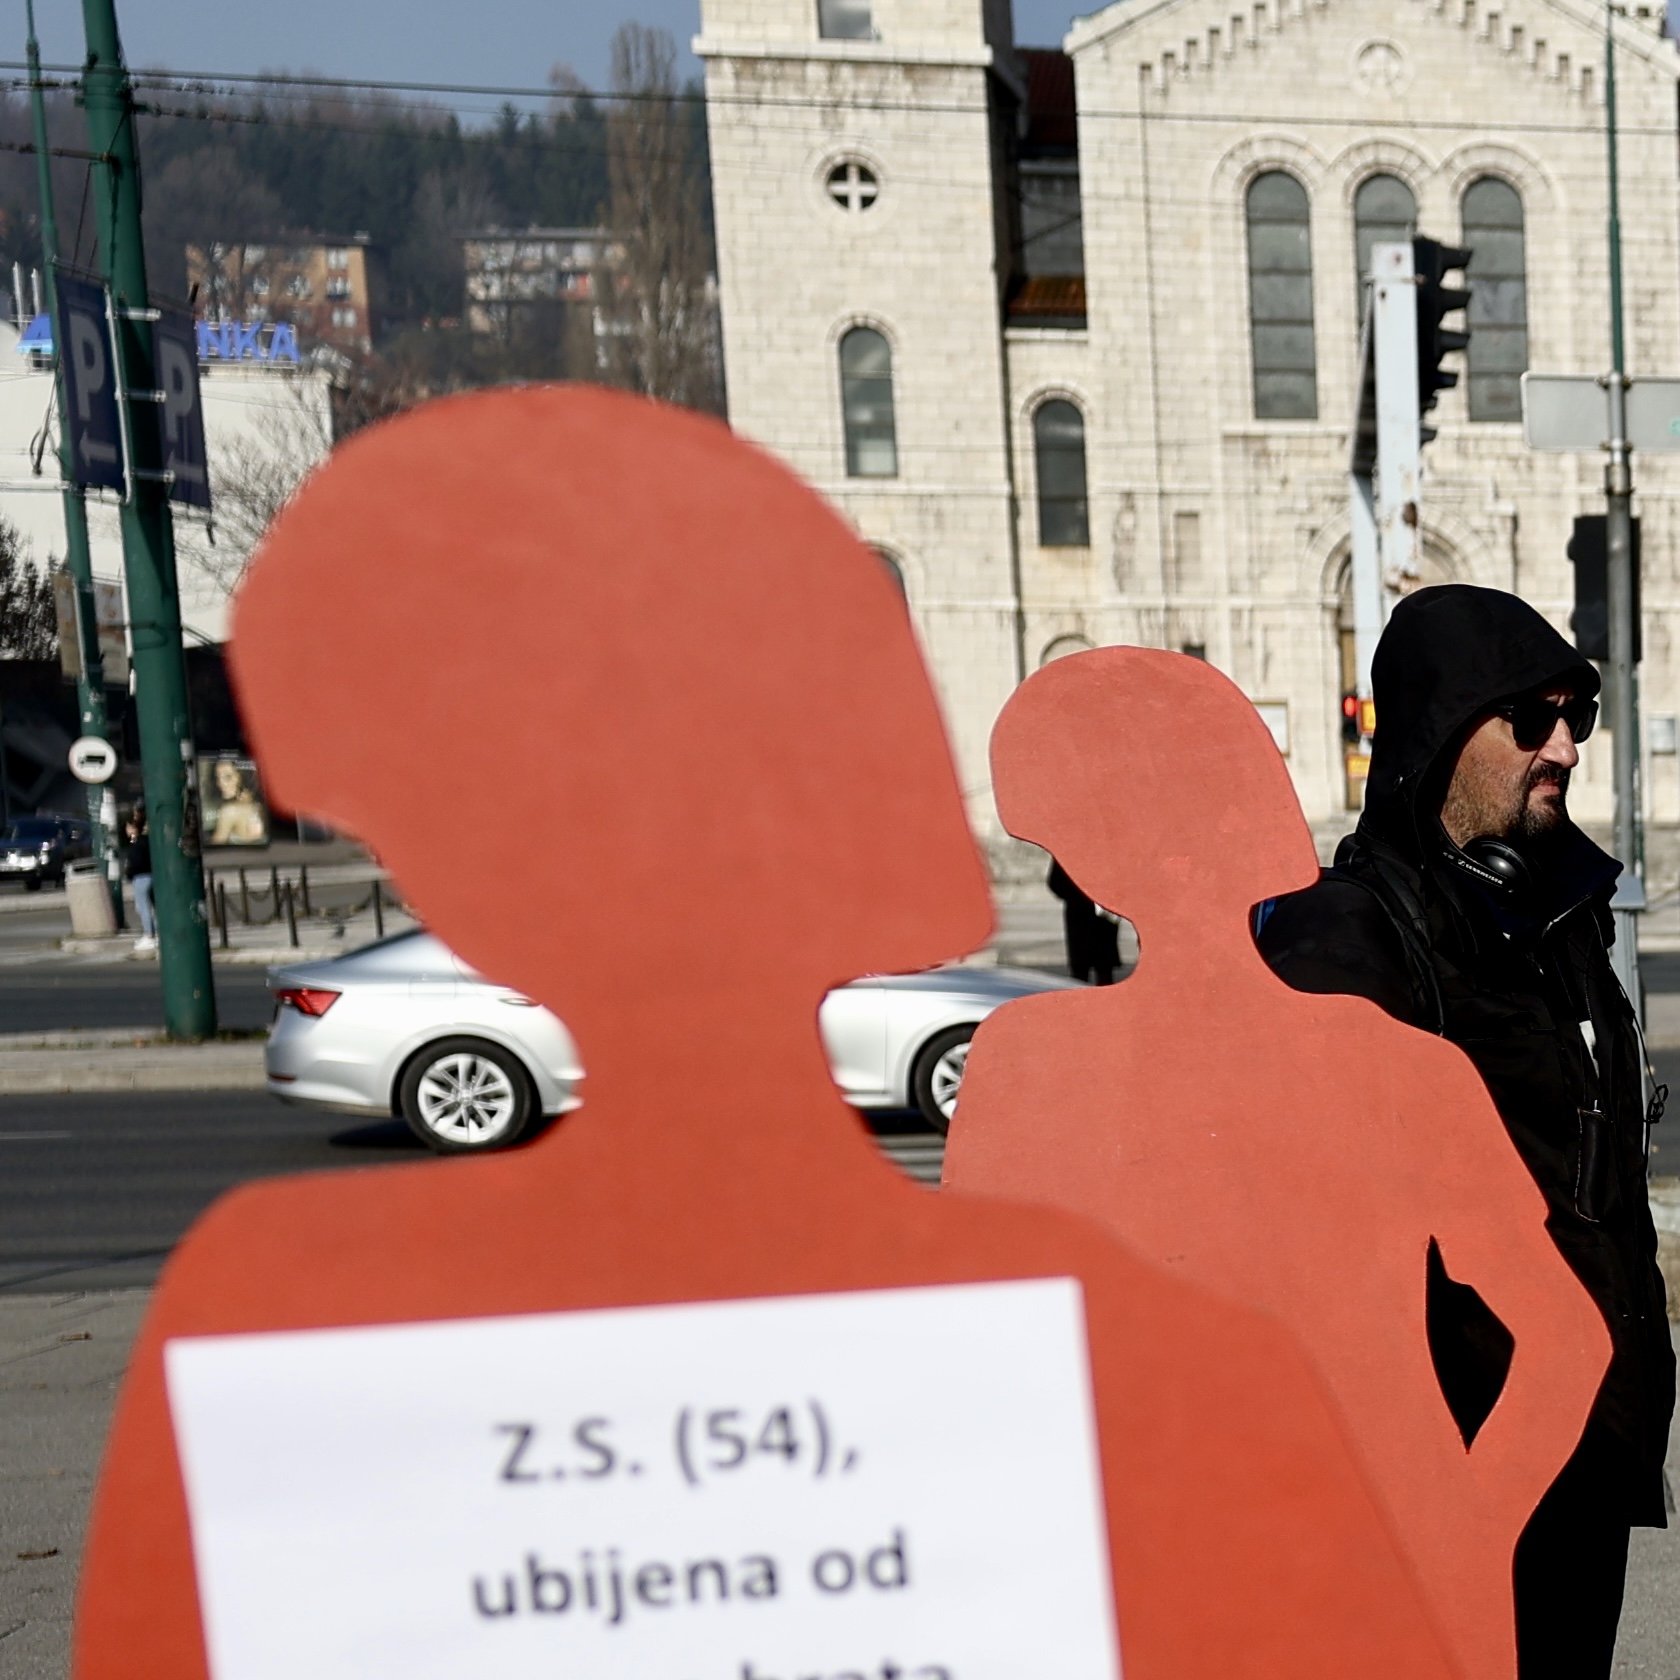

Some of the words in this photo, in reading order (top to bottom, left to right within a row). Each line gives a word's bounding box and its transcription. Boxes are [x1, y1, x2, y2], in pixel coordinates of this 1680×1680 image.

[68, 310, 105, 421] P
[158, 336, 194, 443] P
[195, 320, 299, 363] NKA
[496, 1417, 643, 1485] Z.S.
[674, 1402, 859, 1486] (54),
[471, 1548, 781, 1628] ubijena
[811, 1528, 911, 1595] od
